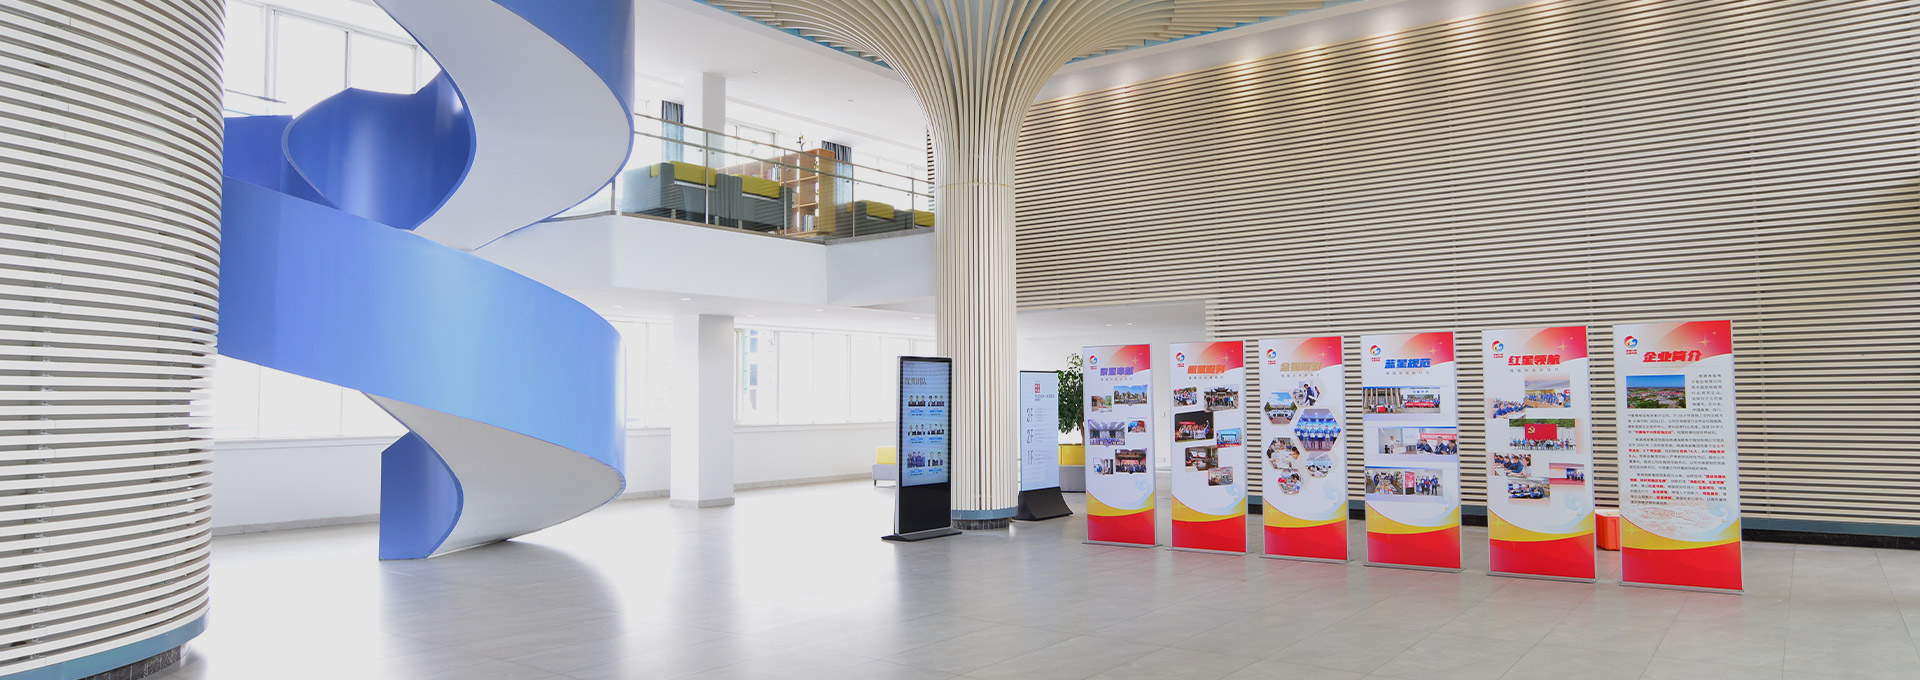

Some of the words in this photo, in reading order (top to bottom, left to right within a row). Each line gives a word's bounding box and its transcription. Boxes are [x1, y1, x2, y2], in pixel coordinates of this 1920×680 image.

[1508, 354, 1561, 366] 红星领航
[1643, 350, 1702, 362] 企业简介
[1384, 358, 1431, 369] 蓝星规范
